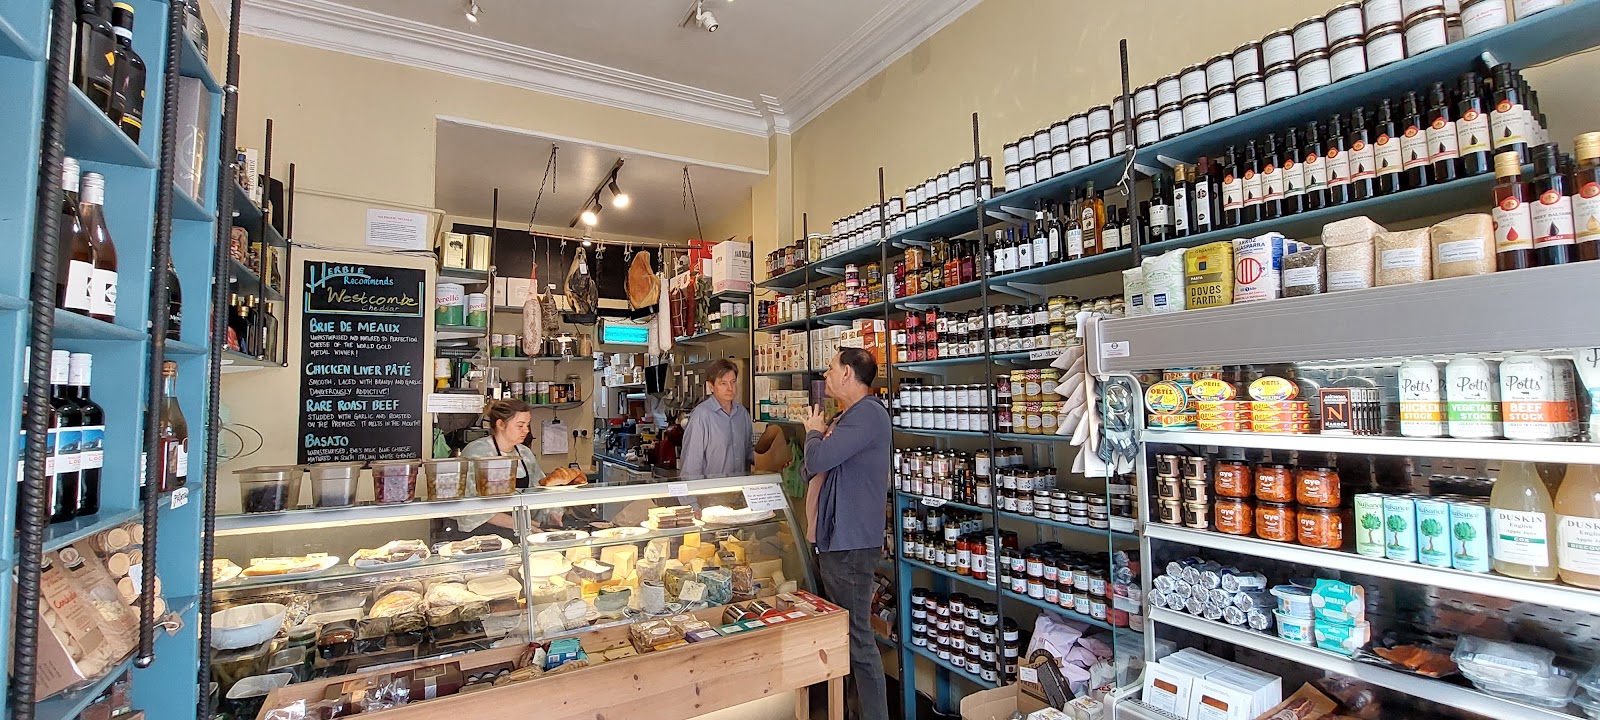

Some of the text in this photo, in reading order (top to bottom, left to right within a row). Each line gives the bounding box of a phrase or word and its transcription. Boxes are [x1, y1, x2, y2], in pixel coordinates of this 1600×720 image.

[306, 262, 371, 293] HERBIE
[343, 276, 394, 286] Recommends
[326, 286, 419, 307] Westcombe
[361, 304, 400, 312] Cheddar
[309, 317, 401, 334] BRIE DE MEAUX
[310, 349, 359, 358] MEDAL WINNER!
[305, 361, 412, 377] CHICKEN LIVER PÂTÉ
[374, 378, 394, 386] BRANDY
[309, 387, 352, 396] DANGEROUSLY
[306, 399, 400, 412] RARE ROAST BEEF
[1452, 403, 1499, 412] VEGETABLE
[1509, 402, 1543, 413] BEEF
[1403, 412, 1433, 420] STOCK
[1460, 412, 1492, 420] STOCK
[1509, 413, 1545, 421] STOCK
[316, 421, 329, 429] THE
[331, 420, 356, 428] PREMISES
[368, 420, 384, 428] MELTS
[304, 433, 349, 448] BASAJO
[378, 446, 391, 454] BLUE
[1219, 471, 1233, 480] aye
[1259, 475, 1274, 484] aye
[1303, 479, 1321, 487] aye
[1220, 508, 1235, 517] aye
[1263, 514, 1279, 522] aye
[1499, 513, 1542, 523] DUSKIN
[1300, 519, 1316, 528] aye
